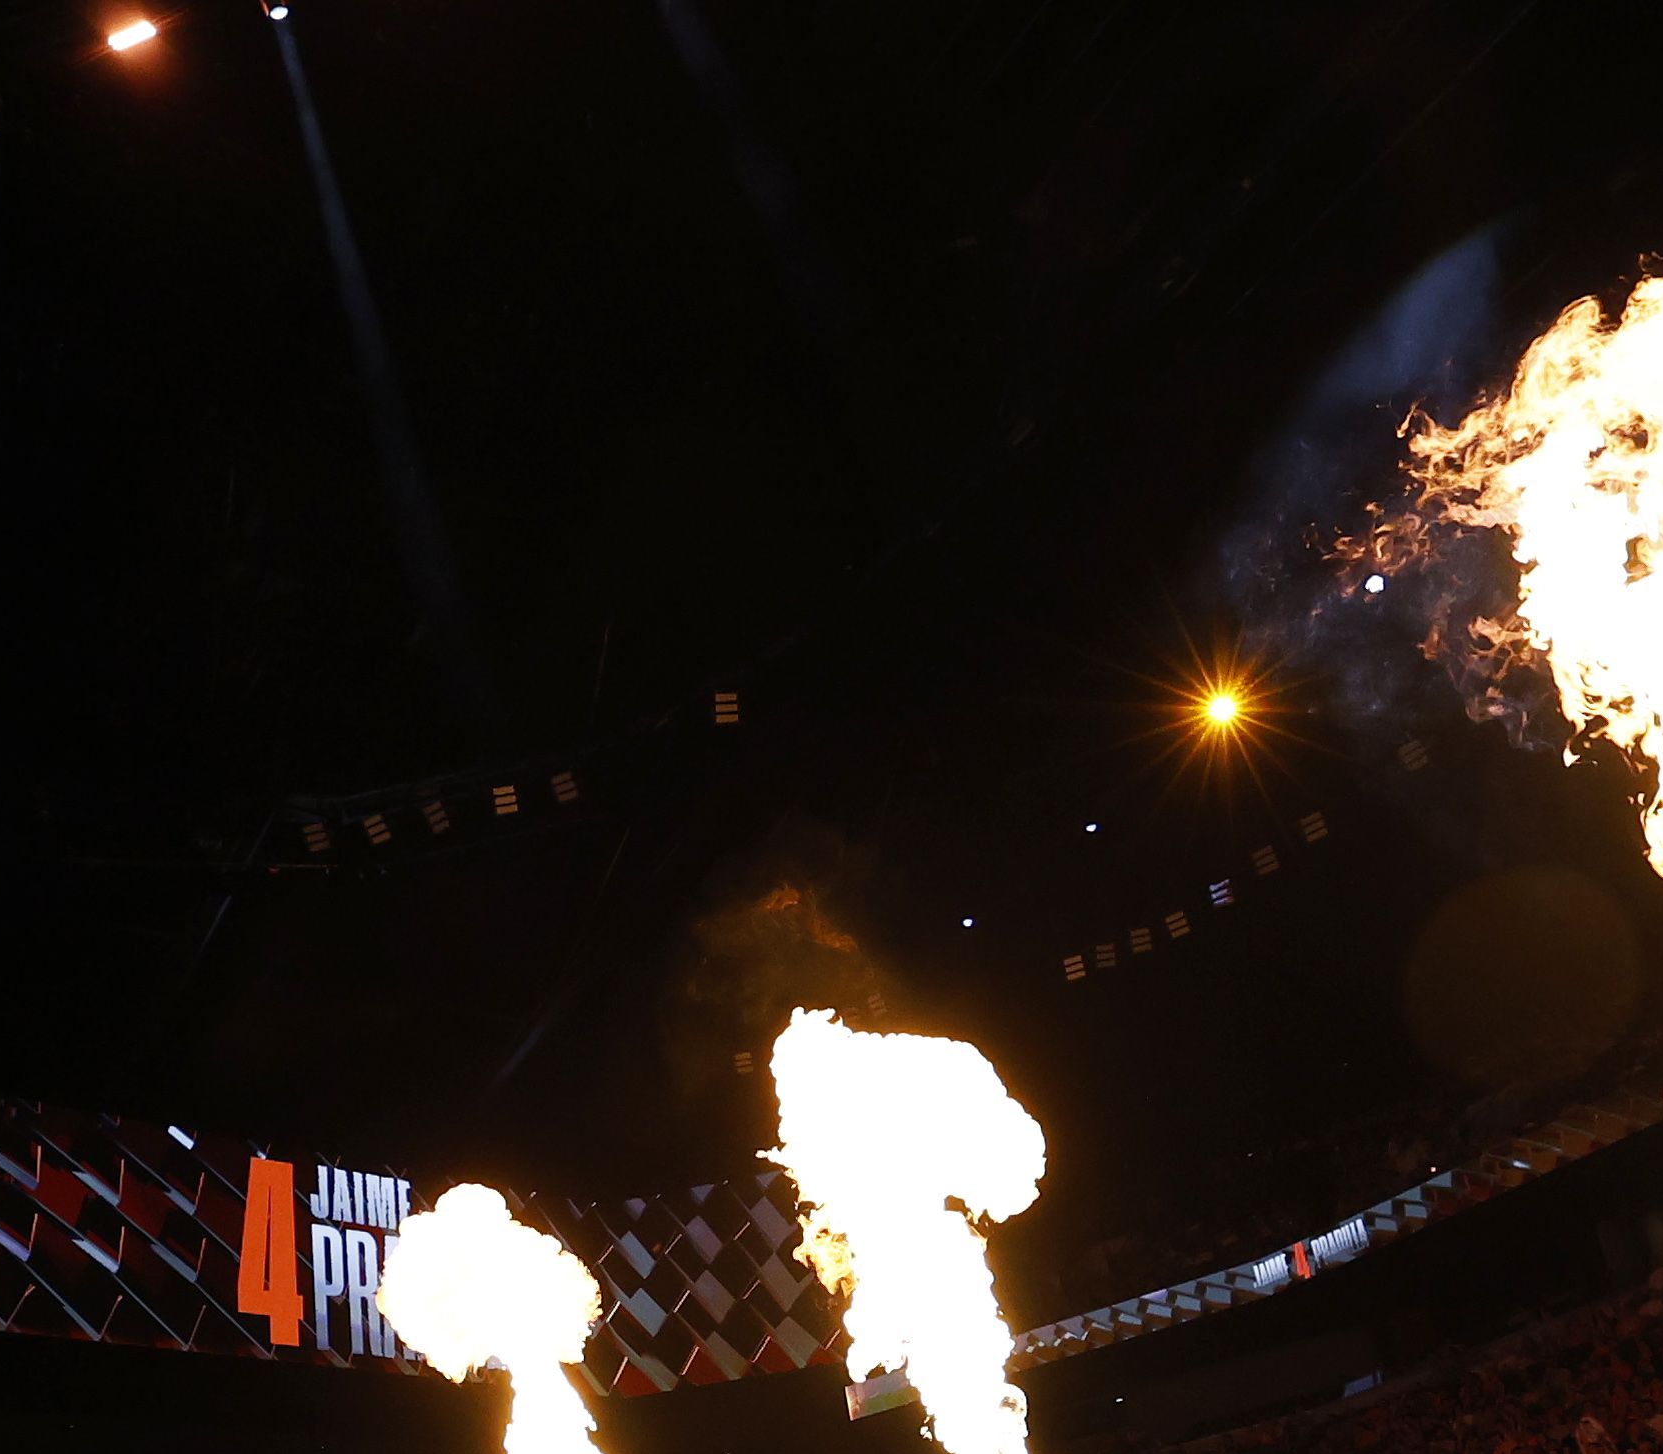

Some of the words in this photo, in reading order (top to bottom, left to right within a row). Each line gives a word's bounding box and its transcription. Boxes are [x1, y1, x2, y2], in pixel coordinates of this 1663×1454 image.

[310, 1164, 411, 1230] JAIME
[238, 1157, 303, 1347] 4
[1253, 1253, 1289, 1288] JAIME
[1294, 1241, 1311, 1279] 4
[1311, 1219, 1369, 1268] PRADILLA
